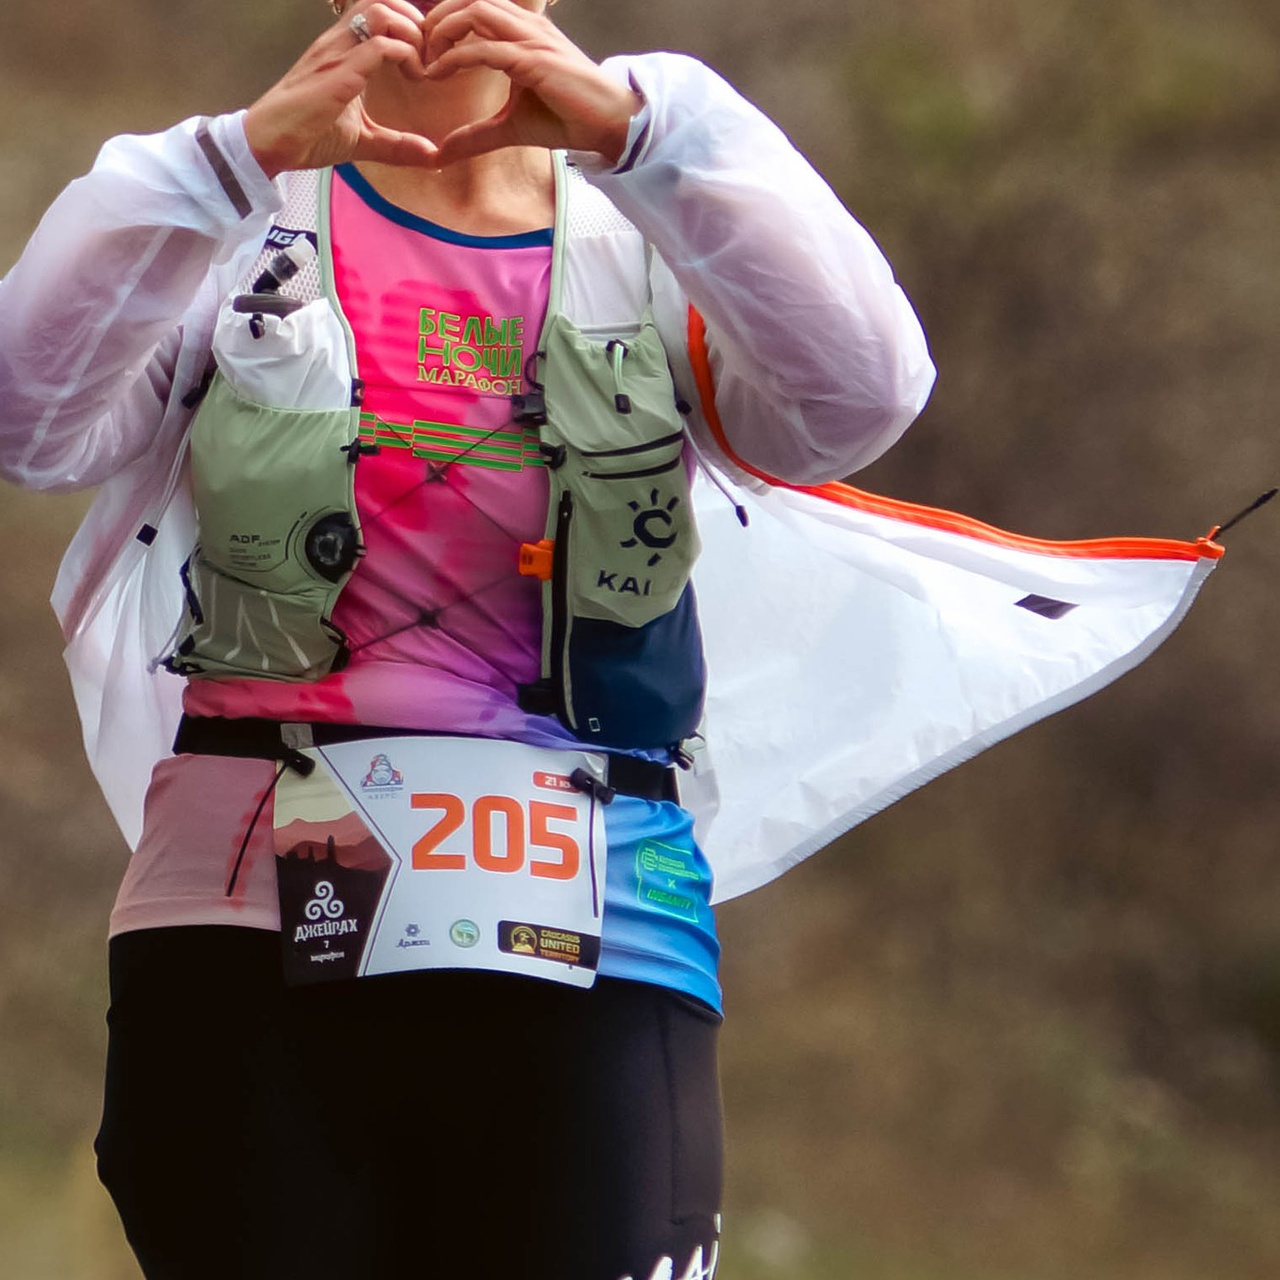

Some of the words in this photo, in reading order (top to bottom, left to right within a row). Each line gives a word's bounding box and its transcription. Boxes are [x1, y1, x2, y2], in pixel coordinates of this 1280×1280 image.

[419, 307, 523, 346] БЕЛЫЕ
[418, 336, 522, 377] НОЧИ
[417, 365, 521, 395] МАРАФОН
[229, 534, 261, 544] ADF
[597, 569, 652, 596] KAI
[545, 775, 557, 787] 21
[410, 793, 580, 880] 205
[294, 919, 359, 943] ДЖЕЙРАХ
[323, 940, 330, 949] 7
[540, 938, 580, 955] UNITED
